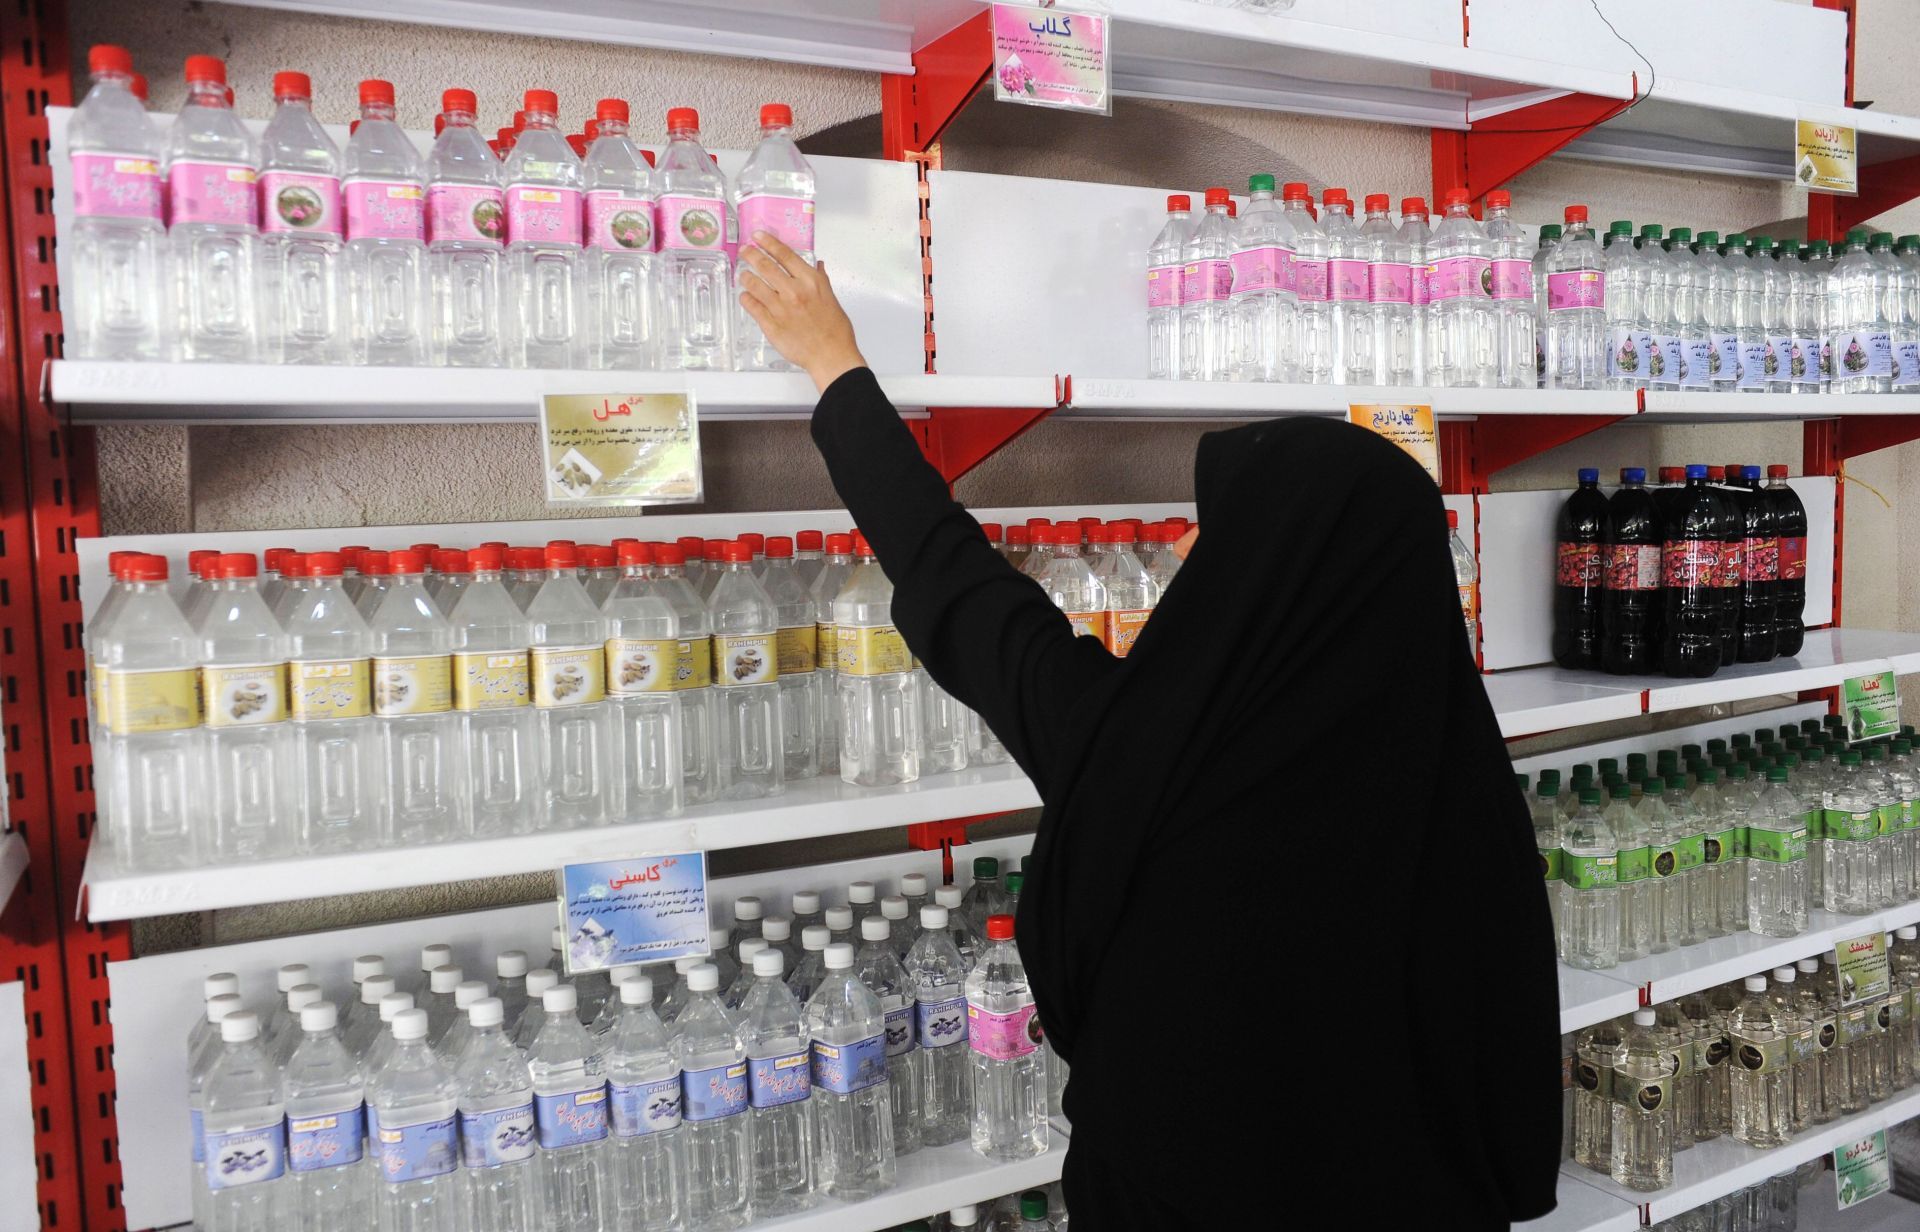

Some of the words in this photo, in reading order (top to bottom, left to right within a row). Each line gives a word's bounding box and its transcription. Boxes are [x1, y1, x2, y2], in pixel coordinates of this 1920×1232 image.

[1029, 16, 1071, 39] گلاب
[593, 399, 631, 422] هل
[1684, 552, 1719, 566] زرشک
[1578, 567, 1601, 580] باران
[1674, 567, 1697, 579] باران
[1068, 616, 1094, 625] HIMPUR
[727, 638, 768, 649] RAHIMPUR
[545, 654, 589, 665] RAHIMPUR
[610, 864, 660, 890] کاسنی
[928, 1003, 964, 1015] RAHIMPUR
[884, 1012, 909, 1023] HIMPUR
[646, 1081, 681, 1095] RAHIMP
[494, 1104, 533, 1123] RAHIMP
